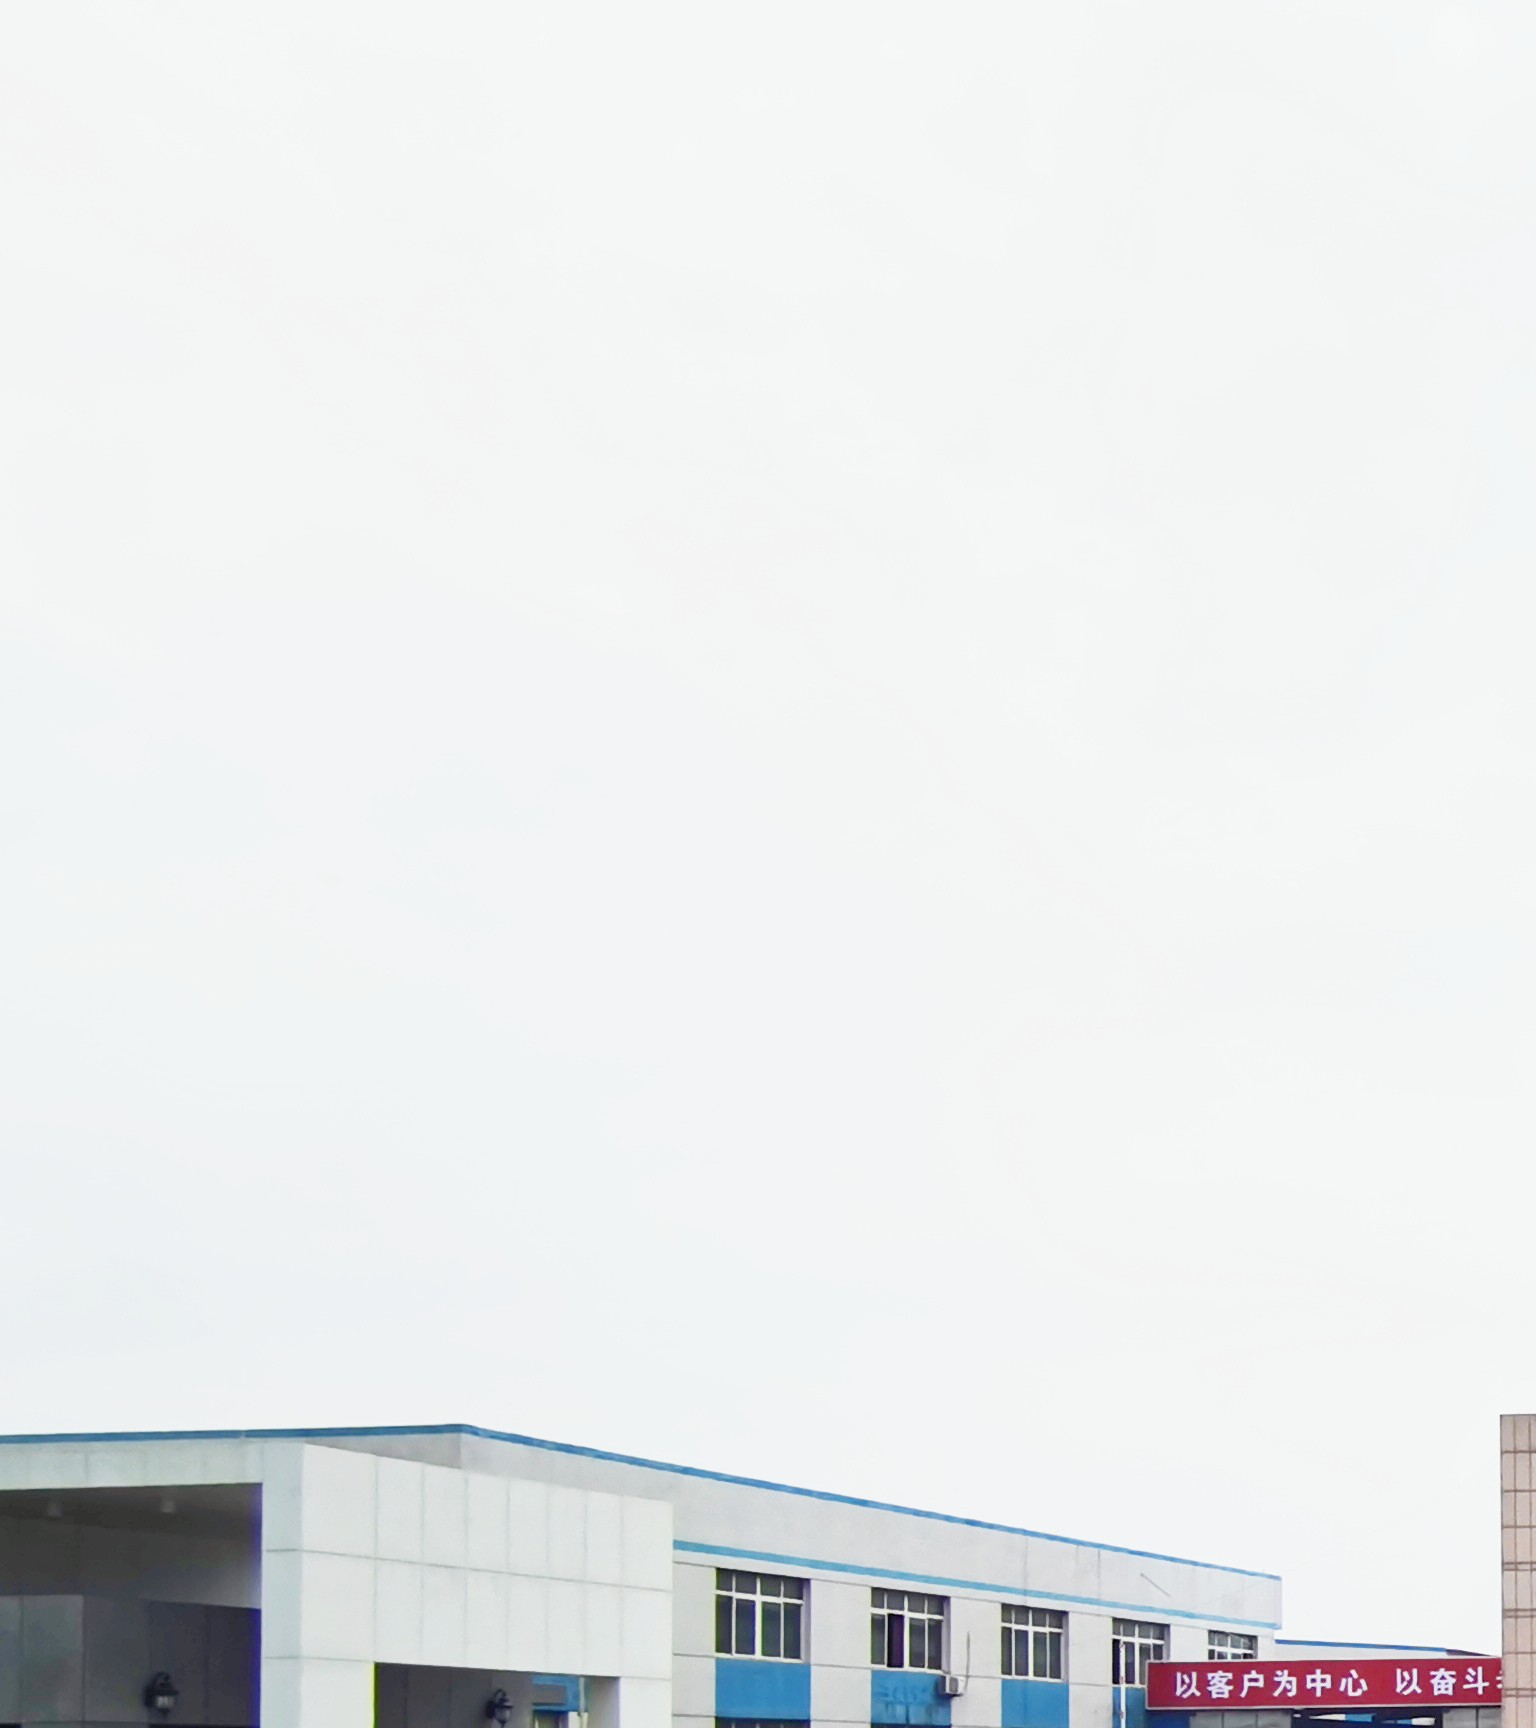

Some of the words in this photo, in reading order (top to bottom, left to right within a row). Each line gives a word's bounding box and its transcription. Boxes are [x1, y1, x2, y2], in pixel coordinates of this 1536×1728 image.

[1175, 1669, 1369, 1699] 以客户为中心
[1394, 1666, 1503, 1696] 以奋斗
